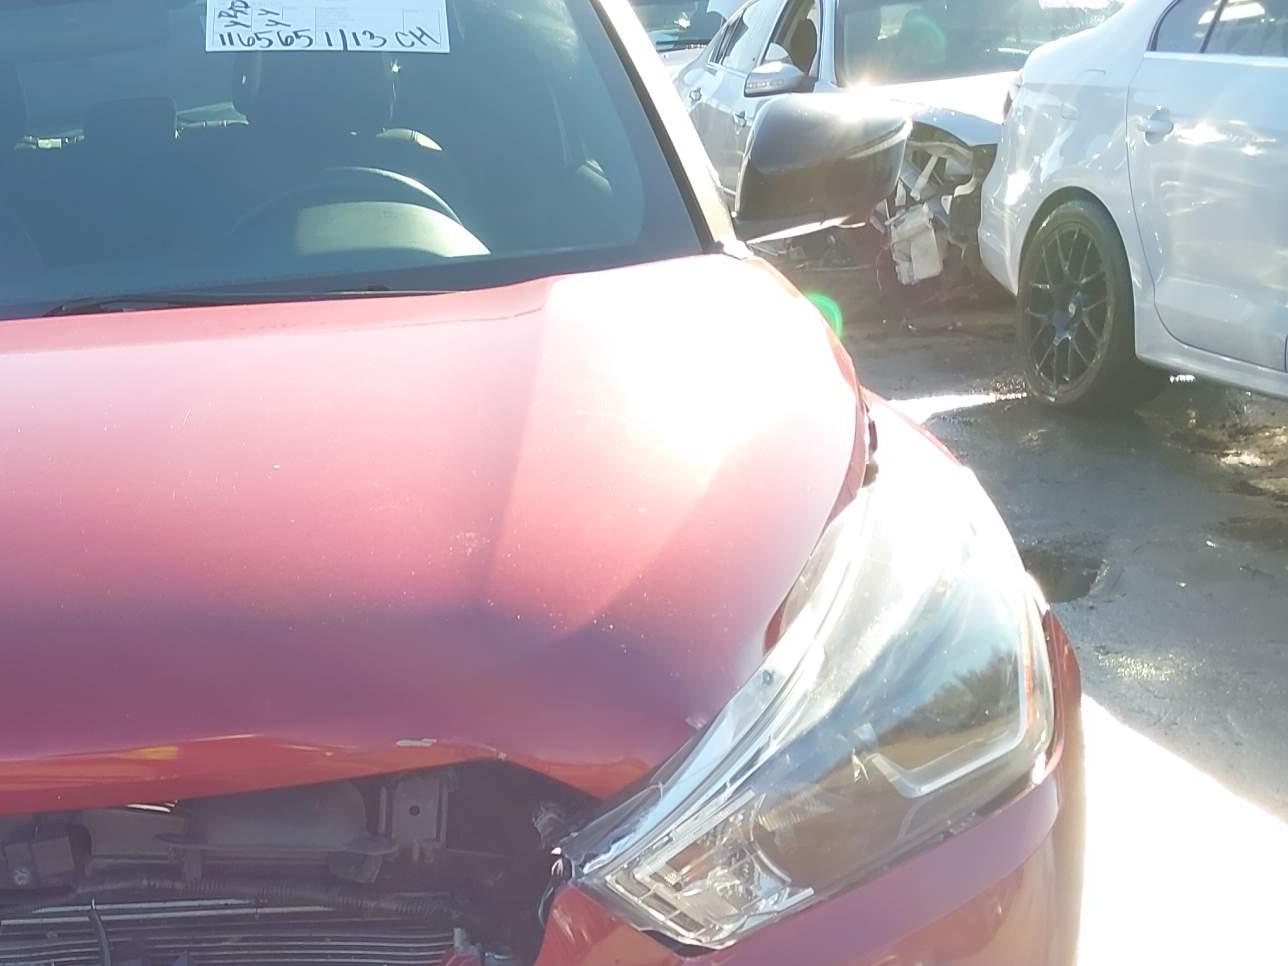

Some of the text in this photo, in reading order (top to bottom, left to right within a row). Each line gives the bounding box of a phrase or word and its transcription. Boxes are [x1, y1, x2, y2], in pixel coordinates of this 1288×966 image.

[219, 26, 440, 51] 116565 1/13 CH
